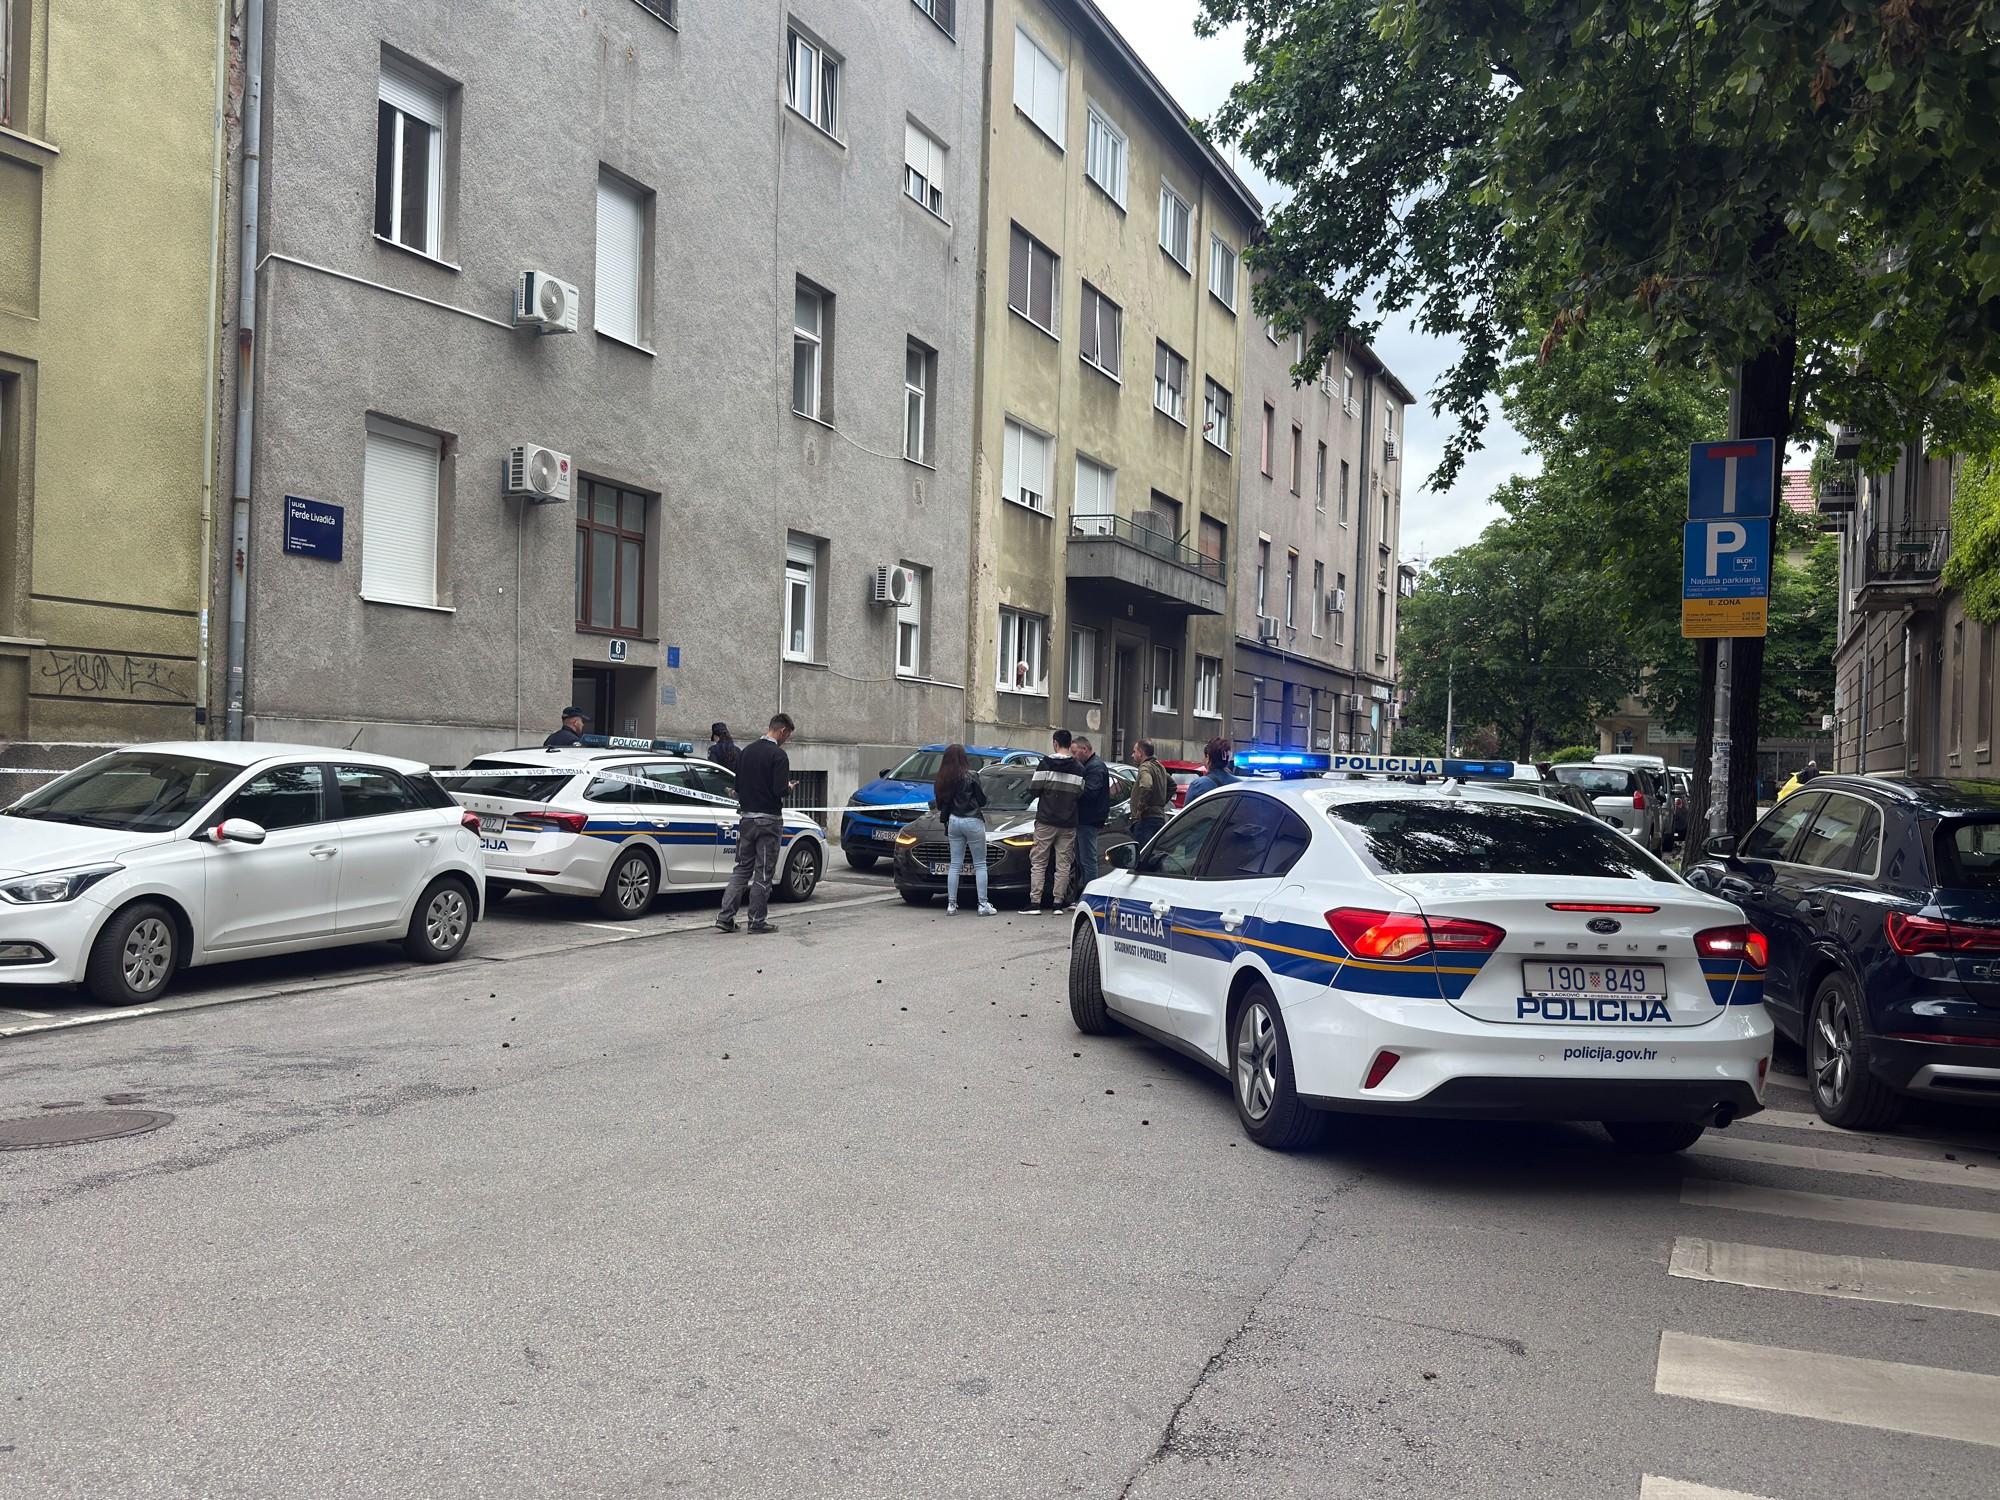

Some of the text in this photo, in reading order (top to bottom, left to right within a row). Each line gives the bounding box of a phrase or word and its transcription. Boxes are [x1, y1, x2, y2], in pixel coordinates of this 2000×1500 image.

[560, 473, 568, 482] LG
[291, 509, 335, 525] Ferde Livadića
[1706, 522, 1747, 576] P
[1690, 576, 1761, 586] Naplata parkiranja
[615, 641, 621, 654] 6
[612, 738, 649, 749] POLICIJA
[1334, 756, 1438, 773] POLICIJA
[597, 771, 642, 785] STOP POLICIJA
[652, 782, 691, 796] STOP POLICIJA
[876, 830, 884, 839] ZG
[480, 837, 509, 851] CIJA
[936, 863, 945, 873] ZG
[1120, 913, 1165, 939] POLICIJA
[1594, 920, 1615, 931] Ford
[1114, 941, 1136, 956] SIGURNOST
[1534, 941, 1668, 951] FOCUS
[1547, 966, 1646, 993] 190 849
[1516, 997, 1672, 1022] POLICIJA
[1563, 1046, 1658, 1063] policija.gov.hr
